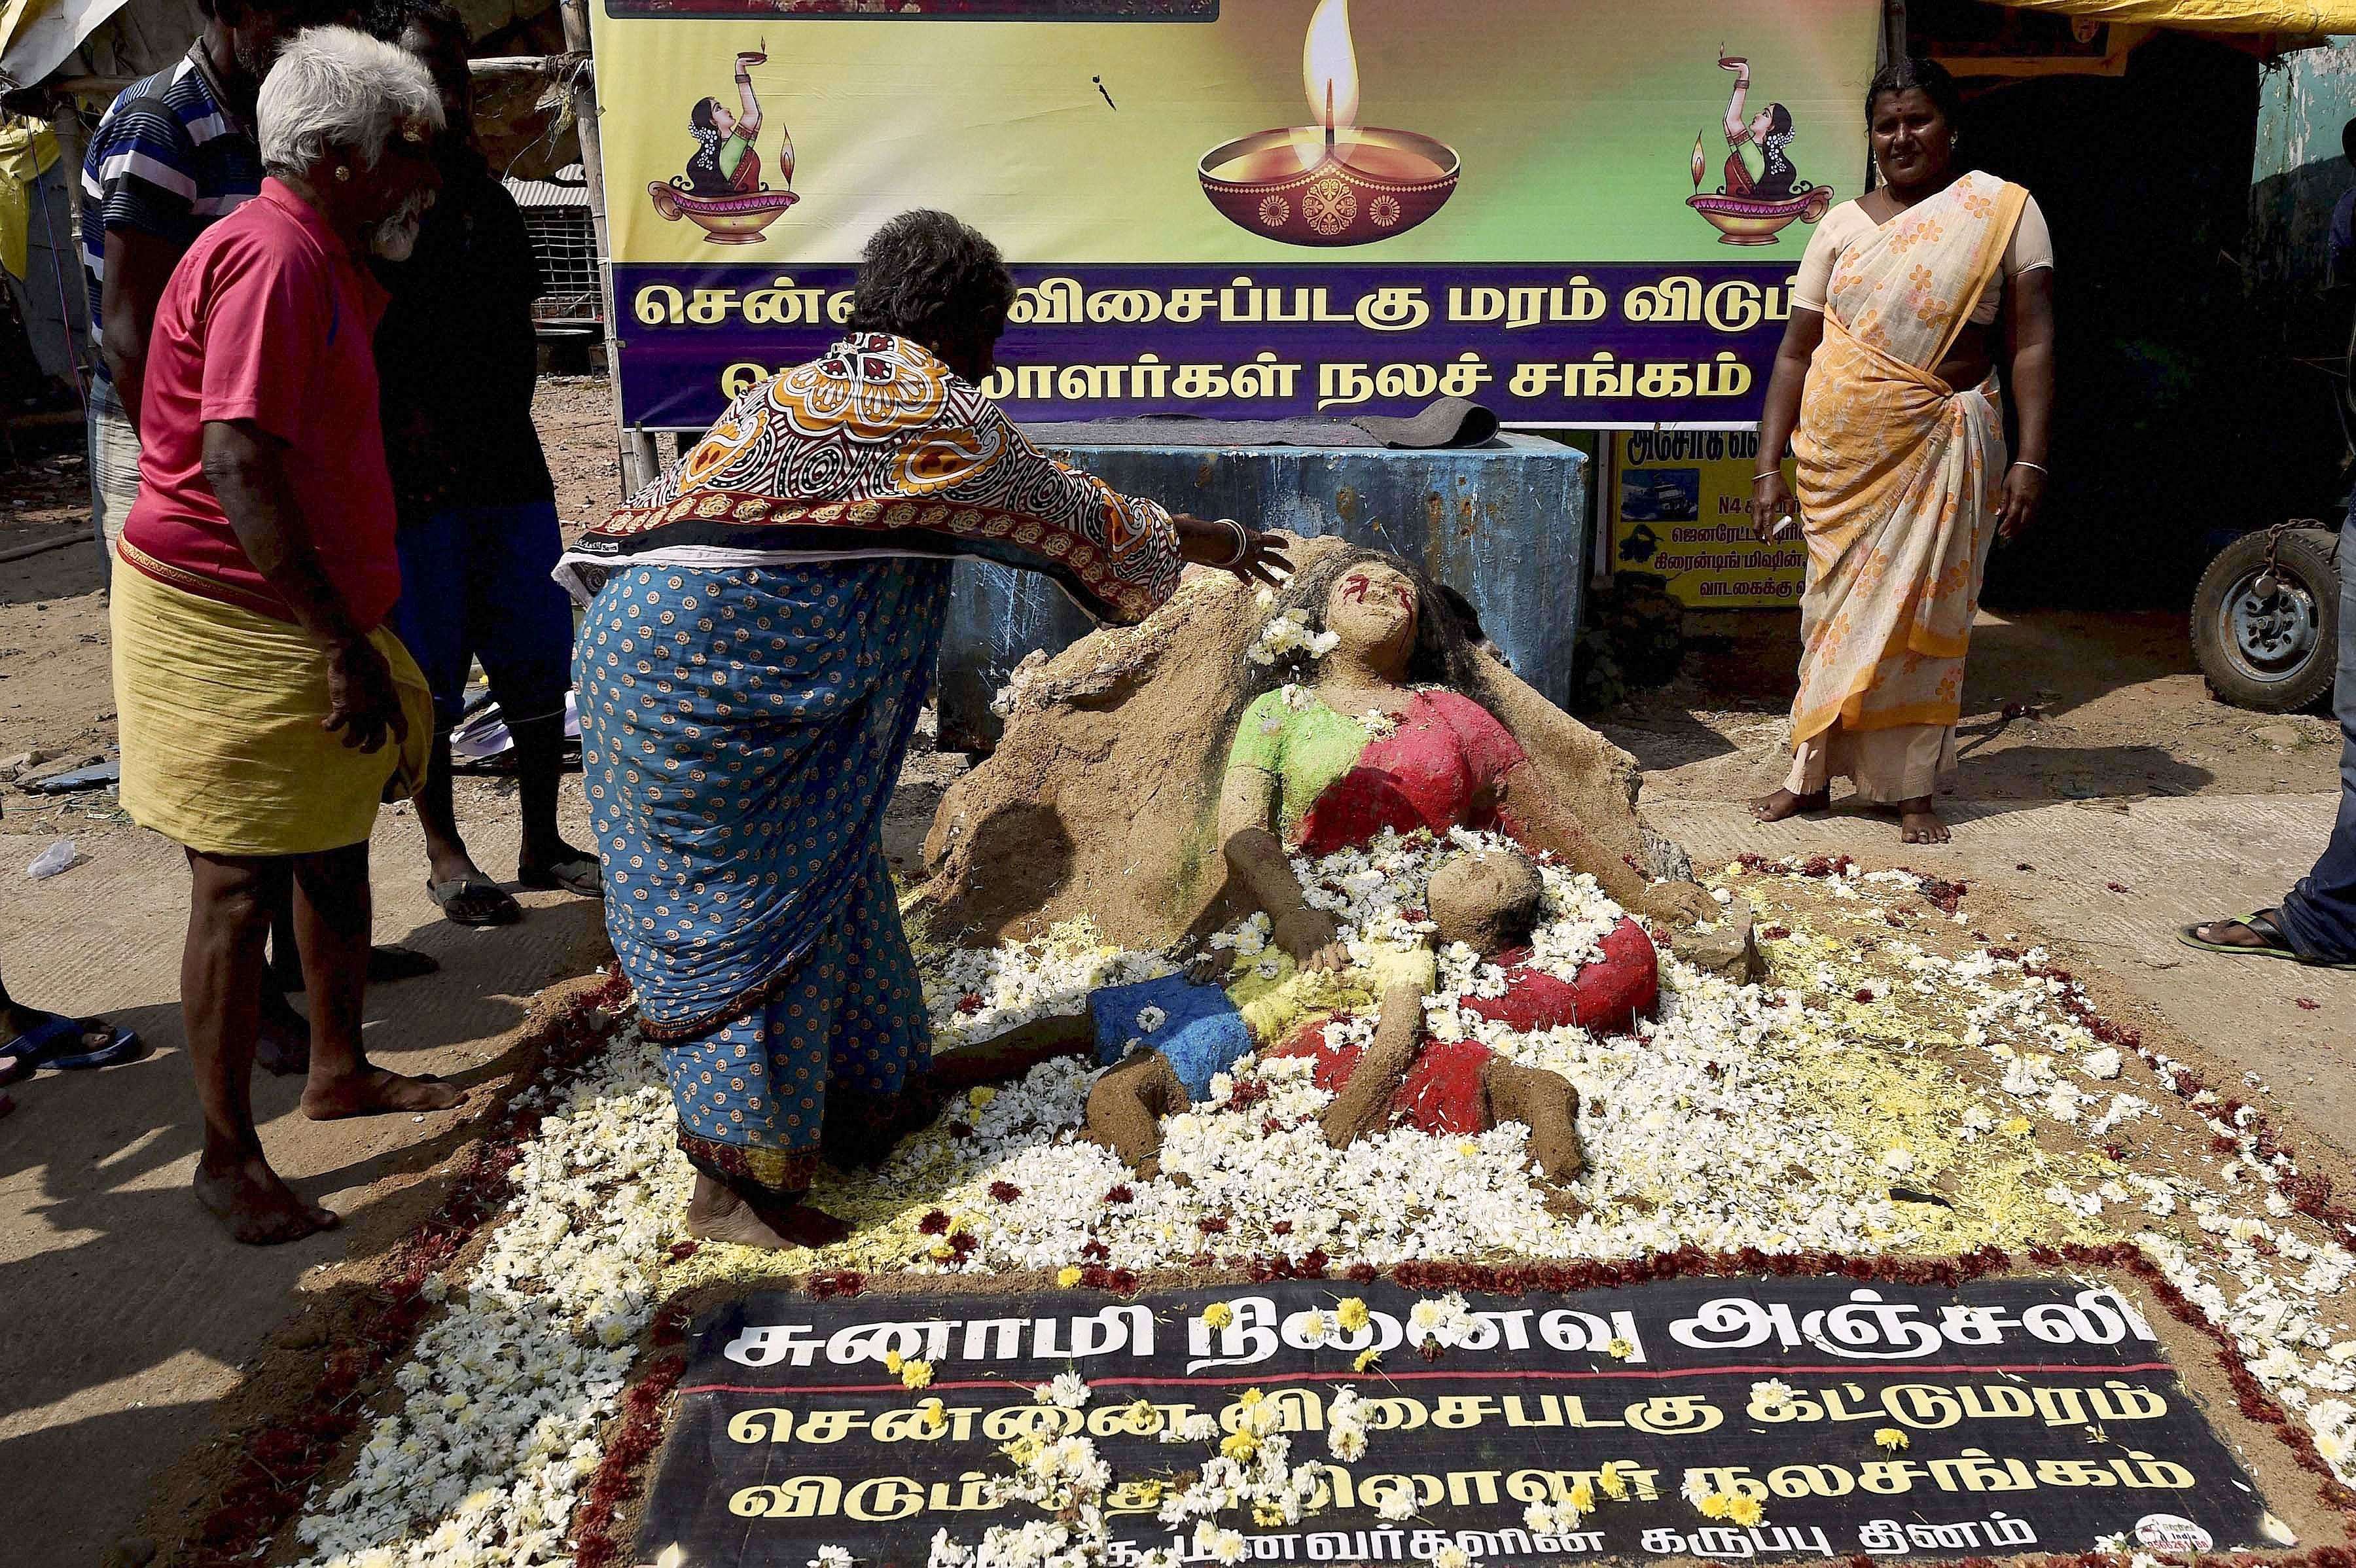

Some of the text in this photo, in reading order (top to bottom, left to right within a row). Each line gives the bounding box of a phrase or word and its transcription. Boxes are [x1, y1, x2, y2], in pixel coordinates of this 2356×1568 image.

[635, 276, 856, 325] சென்
[1007, 276, 1429, 331] விசைப்படகு
[1447, 276, 1606, 330] மரம்
[1317, 351, 1492, 412] நலச்
[1508, 351, 1752, 398] சங்கம்
[724, 1288, 2158, 1376] சுனாமி நினைவு அஞ்சலி
[727, 1397, 1196, 1444] சென்னை
[1747, 1380, 2168, 1429] கட்டுமரம்
[1641, 1520, 1834, 1558] கருப்பு
[1858, 1510, 2038, 1555] தினம்
